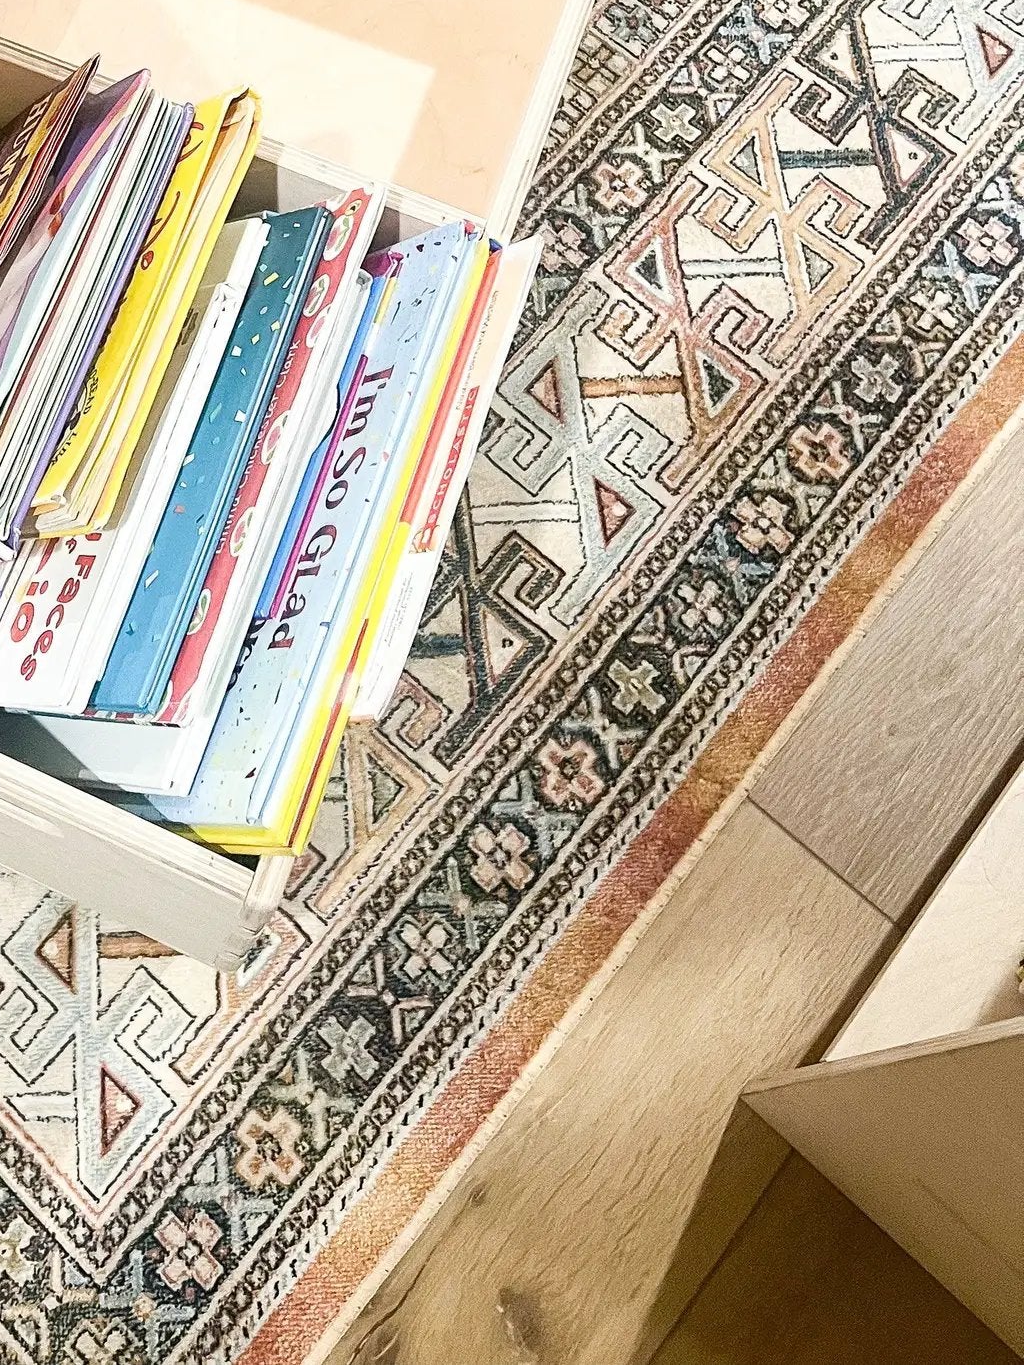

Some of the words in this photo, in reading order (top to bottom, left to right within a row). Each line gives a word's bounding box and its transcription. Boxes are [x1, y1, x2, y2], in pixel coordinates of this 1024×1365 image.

[342, 364, 396, 441] I'm
[324, 445, 367, 510] So
[427, 387, 476, 523] SCHOLASTIC
[20, 554, 97, 682] Faces
